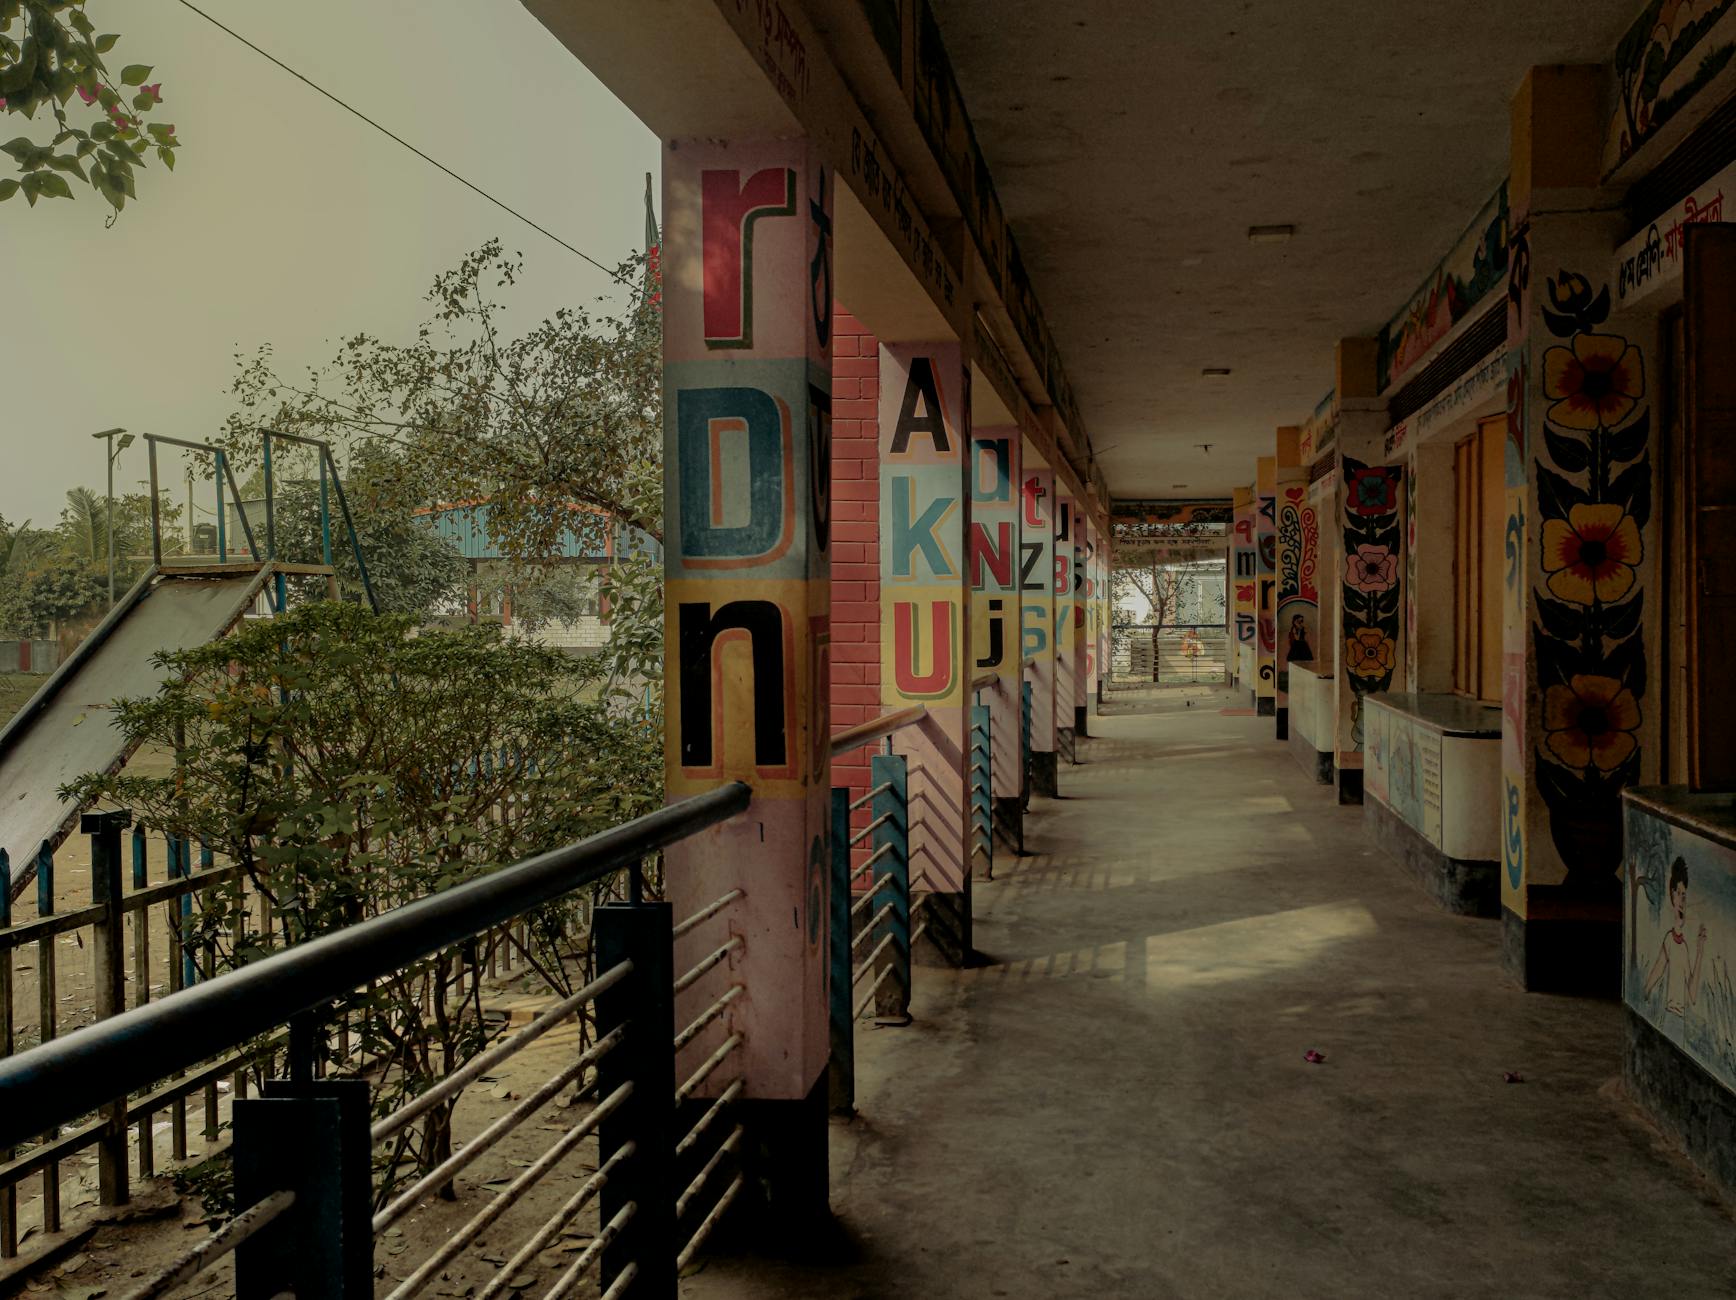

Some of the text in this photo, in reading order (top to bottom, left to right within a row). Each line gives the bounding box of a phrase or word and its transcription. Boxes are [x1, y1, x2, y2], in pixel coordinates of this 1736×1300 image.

[702, 167, 795, 348] r
[890, 357, 953, 455] A
[677, 388, 790, 565] D
[1022, 478, 1044, 527] t
[972, 522, 1012, 588] N
[894, 602, 955, 698] U
[977, 600, 1002, 667] j
[679, 601, 789, 771] n
